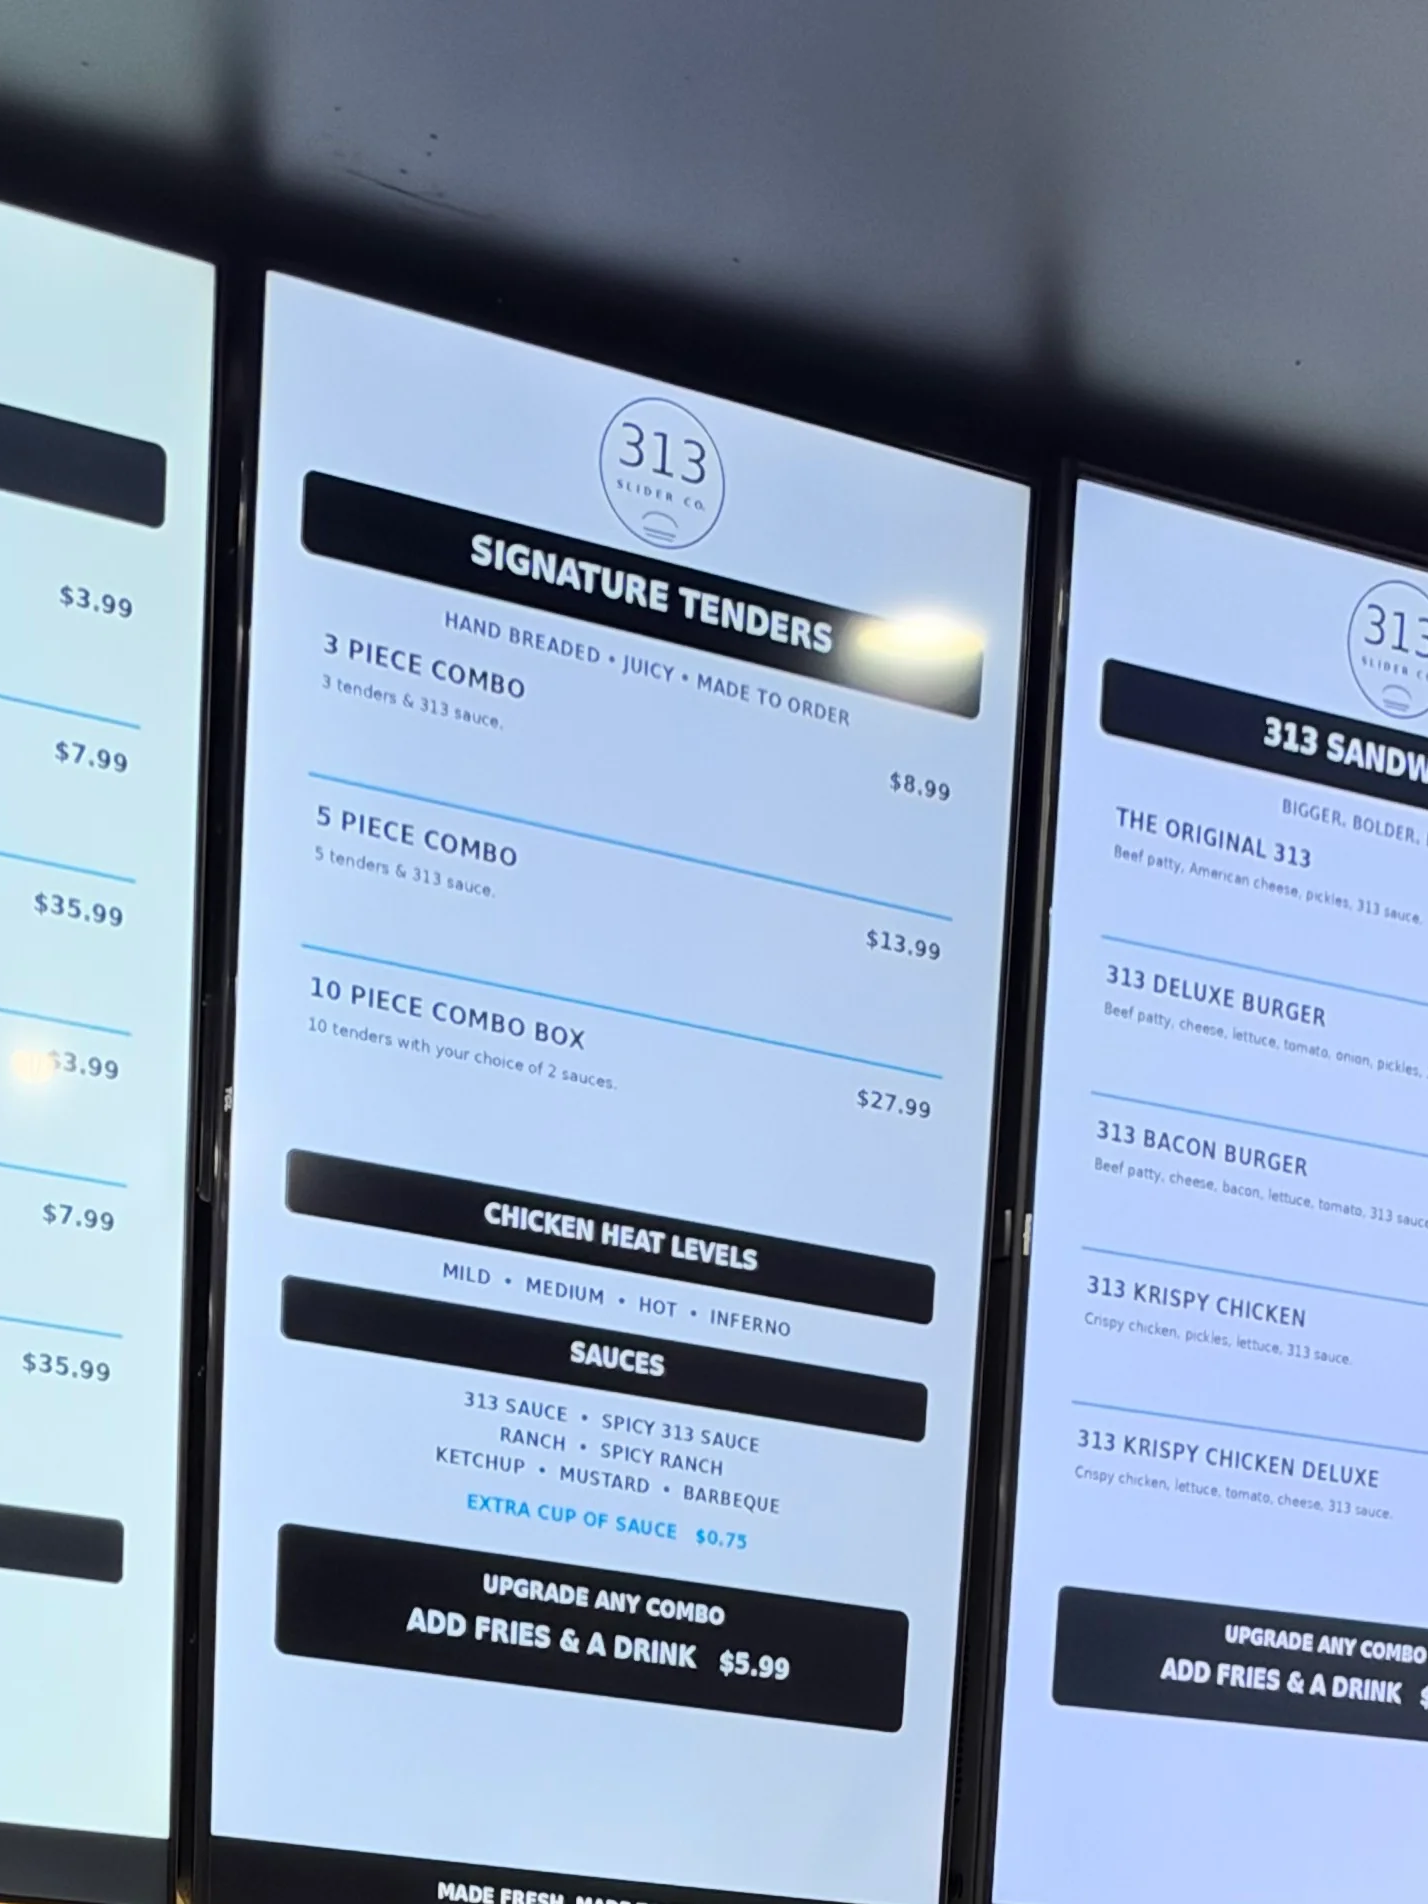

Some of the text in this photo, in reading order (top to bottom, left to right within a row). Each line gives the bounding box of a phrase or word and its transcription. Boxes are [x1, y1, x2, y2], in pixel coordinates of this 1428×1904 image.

[619, 422, 705, 484] 313
[60, 585, 132, 618] $3.99
[471, 534, 831, 652] SIGNATURE TENDERS
[324, 634, 524, 698] 3 PIECE COMBO
[323, 674, 503, 729] 3 tenders & 313 sauce.
[56, 741, 127, 772] $7.99
[1263, 716, 1318, 756] 313
[890, 772, 950, 801] $8.99
[1116, 806, 1310, 868] THE ORIGINAL 313
[1282, 798, 1346, 827] BIGGER.
[1352, 814, 1419, 845] BOLDER.
[34, 892, 123, 927] $35.99
[311, 977, 584, 1049] 10 PIECE COMBO BOX
[1107, 964, 1324, 1027] 313 DELUXE BURGER
[857, 1089, 930, 1118] $27.99
[23, 1352, 110, 1382] $35.99
[570, 1340, 665, 1376] SAUCES
[465, 1391, 758, 1453] 313 SAUCE SPICY 313 SAUCE
[436, 1446, 778, 1514] KETCHUP MUSTARD BARBEQUE
[1078, 1429, 1378, 1488] 313 KRISPY CHICKEN DELUXE
[467, 1493, 746, 1549] EXTRA CUP OF SAUCE $0.75
[483, 1573, 725, 1626] UPGRADE ANY COMBO
[406, 1607, 790, 1680] ADD FRIES & A DRINK $5.99
